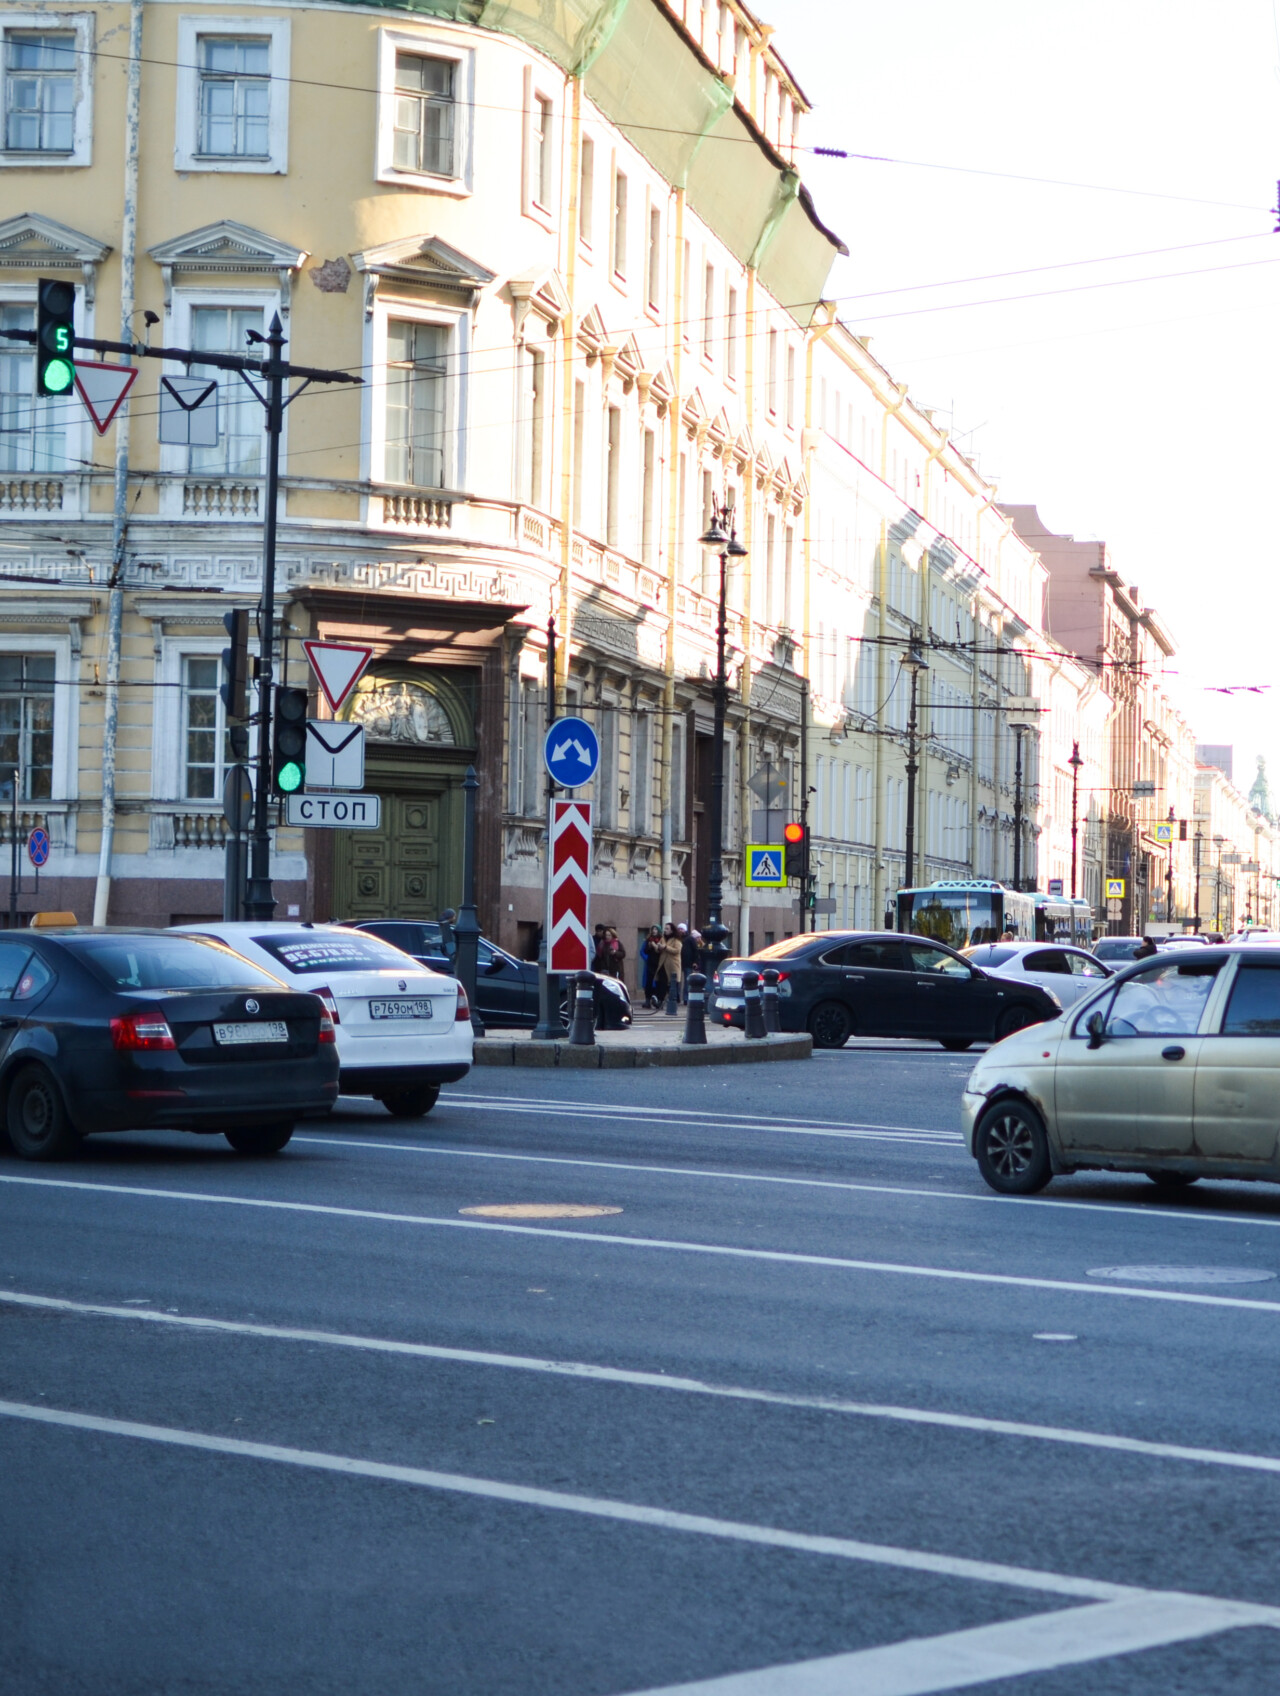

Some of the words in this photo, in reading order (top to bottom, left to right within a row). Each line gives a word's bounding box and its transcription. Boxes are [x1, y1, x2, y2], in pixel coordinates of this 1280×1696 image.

[56, 328, 68, 350] 5
[300, 800, 366, 821] СТОП
[374, 1002, 413, 1014] Р769ОМ
[414, 1001, 429, 1011] 198
[268, 1022, 285, 1033] 198
